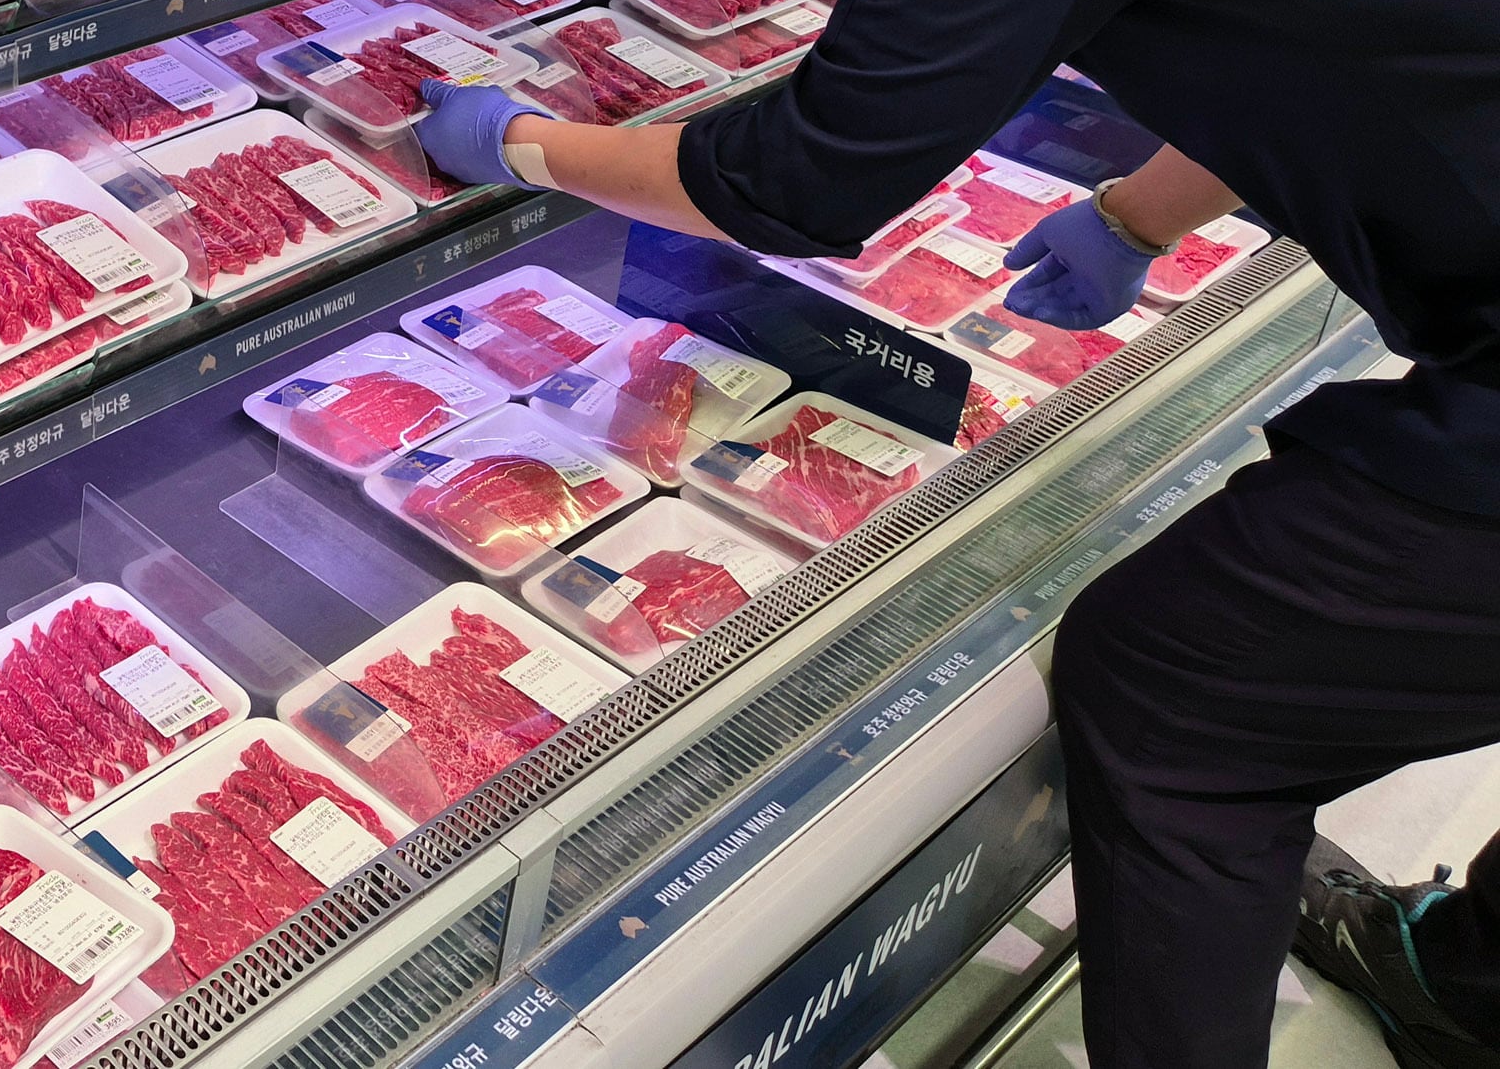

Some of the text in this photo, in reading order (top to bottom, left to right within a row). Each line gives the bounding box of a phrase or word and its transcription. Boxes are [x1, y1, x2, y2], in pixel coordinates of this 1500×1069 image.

[49, 21, 98, 51] 달링다운
[443, 205, 548, 264] 호주 달링다운
[235, 291, 356, 357] PURE AUSTRALIAN WAGYU
[844, 326, 936, 389] 국거리용
[13, 423, 65, 458] 청정와규
[80, 392, 131, 429] 달링다운
[862, 651, 974, 739] 호주 청정와규 달링다운
[654, 800, 787, 908] PURE AUSTRALIAN WAGYU
[115, 924, 137, 942] 33289
[866, 841, 984, 979] WAGYU
[493, 988, 558, 1039] 달링다운
